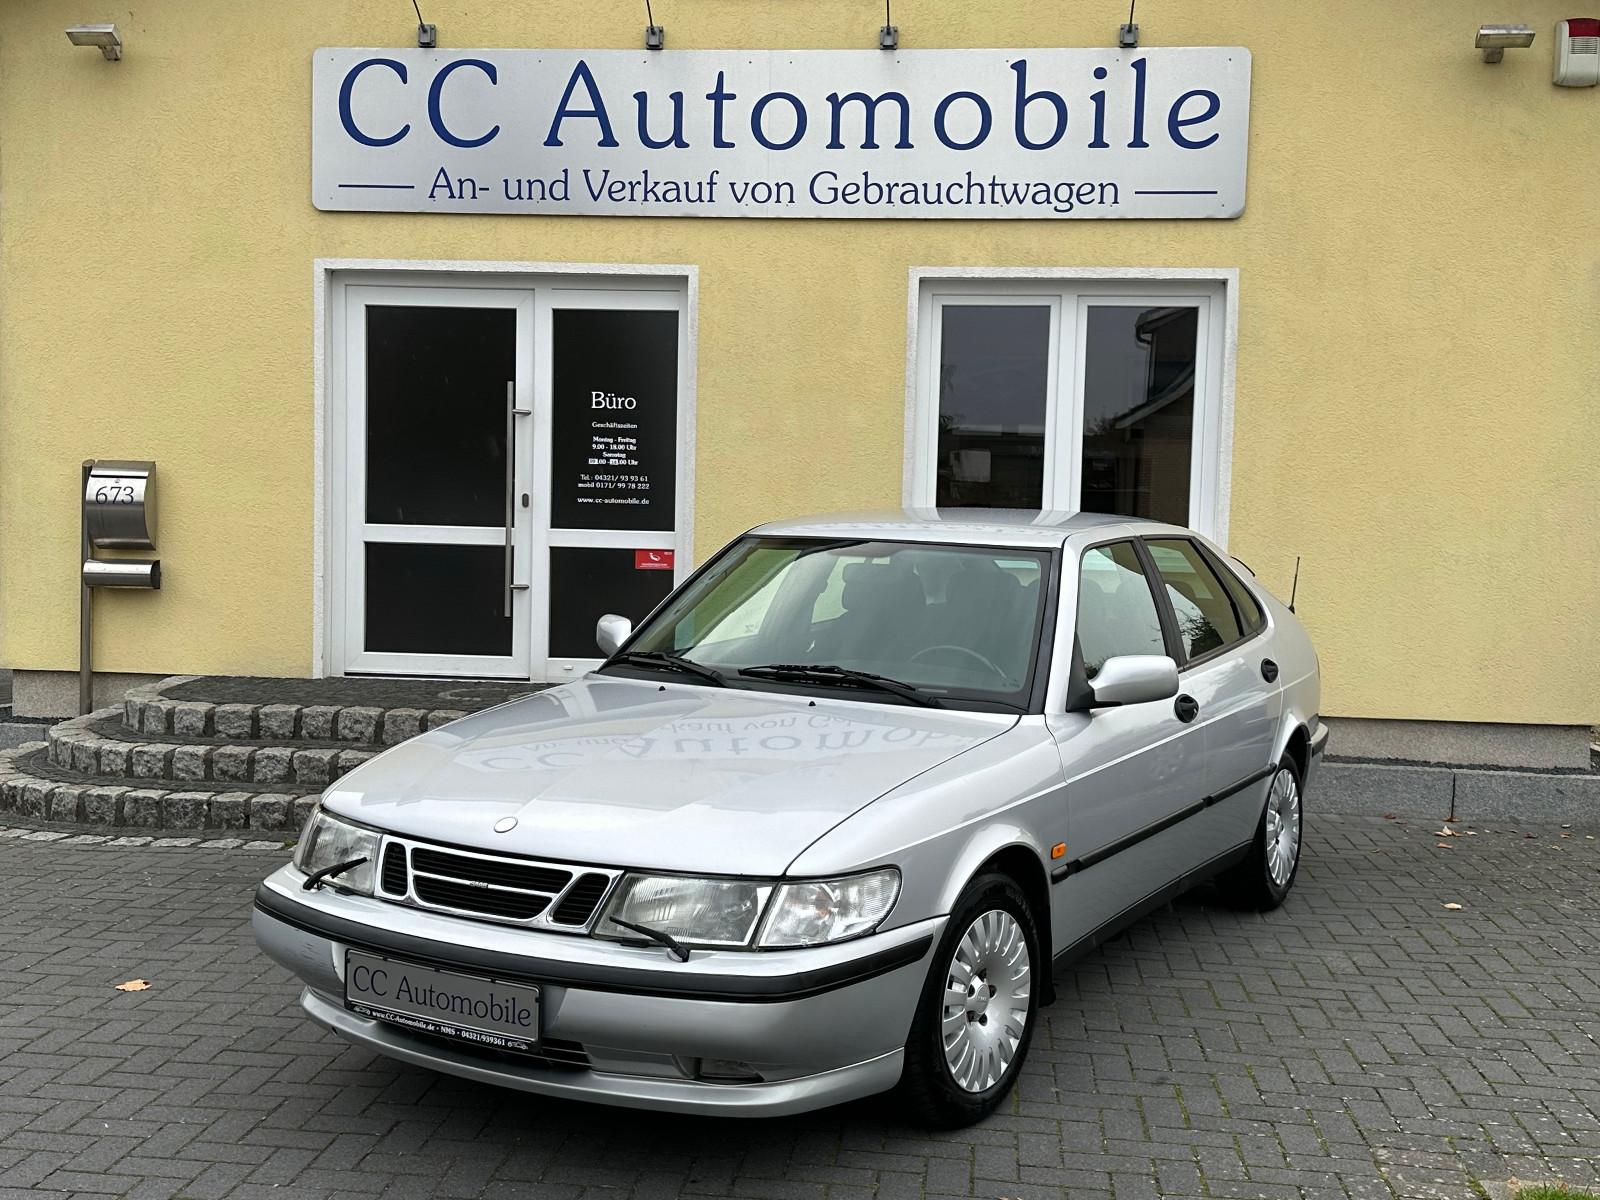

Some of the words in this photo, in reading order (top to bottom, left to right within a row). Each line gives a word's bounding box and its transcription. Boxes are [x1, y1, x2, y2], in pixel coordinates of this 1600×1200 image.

[338, 58, 500, 149] CC
[543, 57, 1221, 151] Automobile
[428, 166, 490, 200] An-
[502, 168, 571, 202] und
[582, 169, 719, 204] Verkauf
[728, 182, 796, 204] von
[808, 171, 1120, 213] Gebrauchtwagen
[591, 391, 637, 410] Büro
[592, 435, 614, 444] Montag
[617, 436, 637, 445] Freitag
[95, 485, 134, 505] 673
[353, 965, 388, 997] CC
[395, 975, 532, 1028] Automobile
[440, 1025, 456, 1036] NMS
[461, 1030, 506, 1047] 04321/939361
